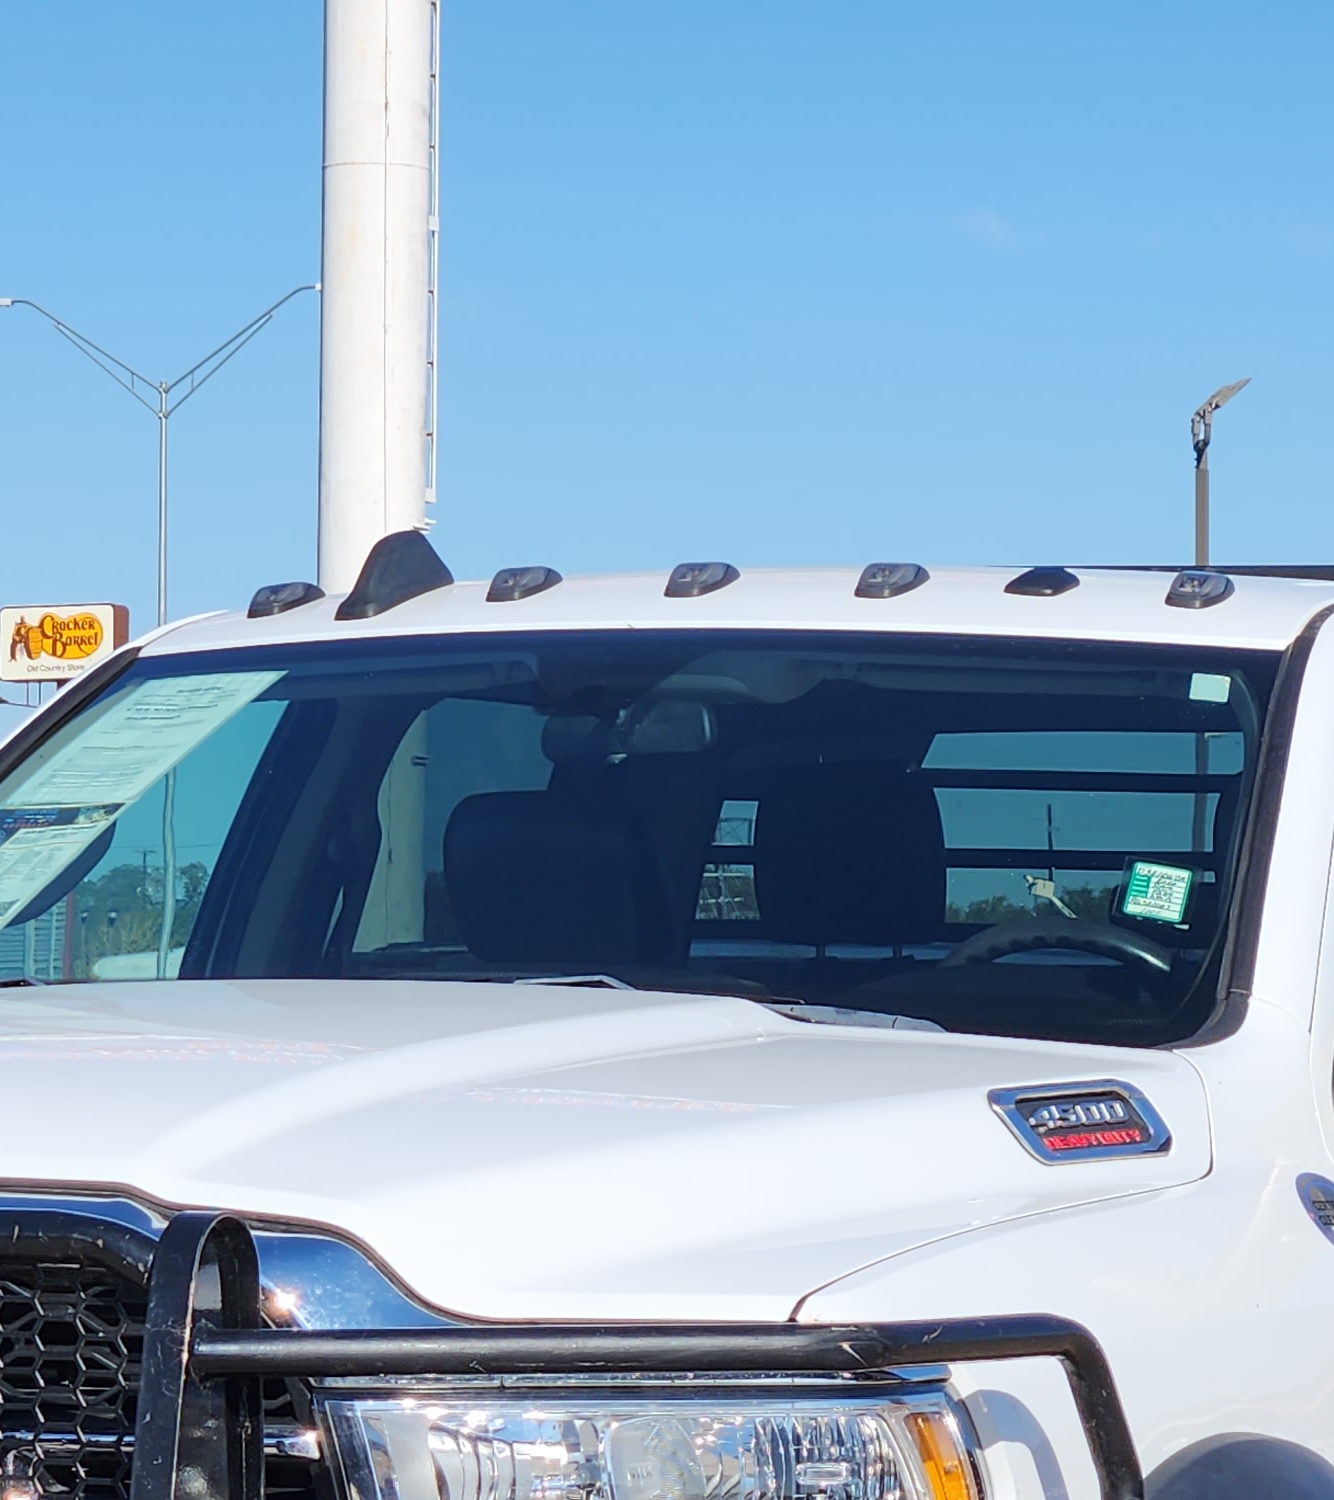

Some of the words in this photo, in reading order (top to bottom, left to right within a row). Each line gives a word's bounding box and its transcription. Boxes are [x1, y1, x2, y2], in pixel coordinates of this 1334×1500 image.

[39, 615, 96, 639] Cracker
[51, 631, 98, 658] Barrel
[27, 664, 39, 673] Old
[40, 664, 65, 673] Country
[67, 663, 85, 672] Store
[1029, 1100, 1130, 1133] 4500
